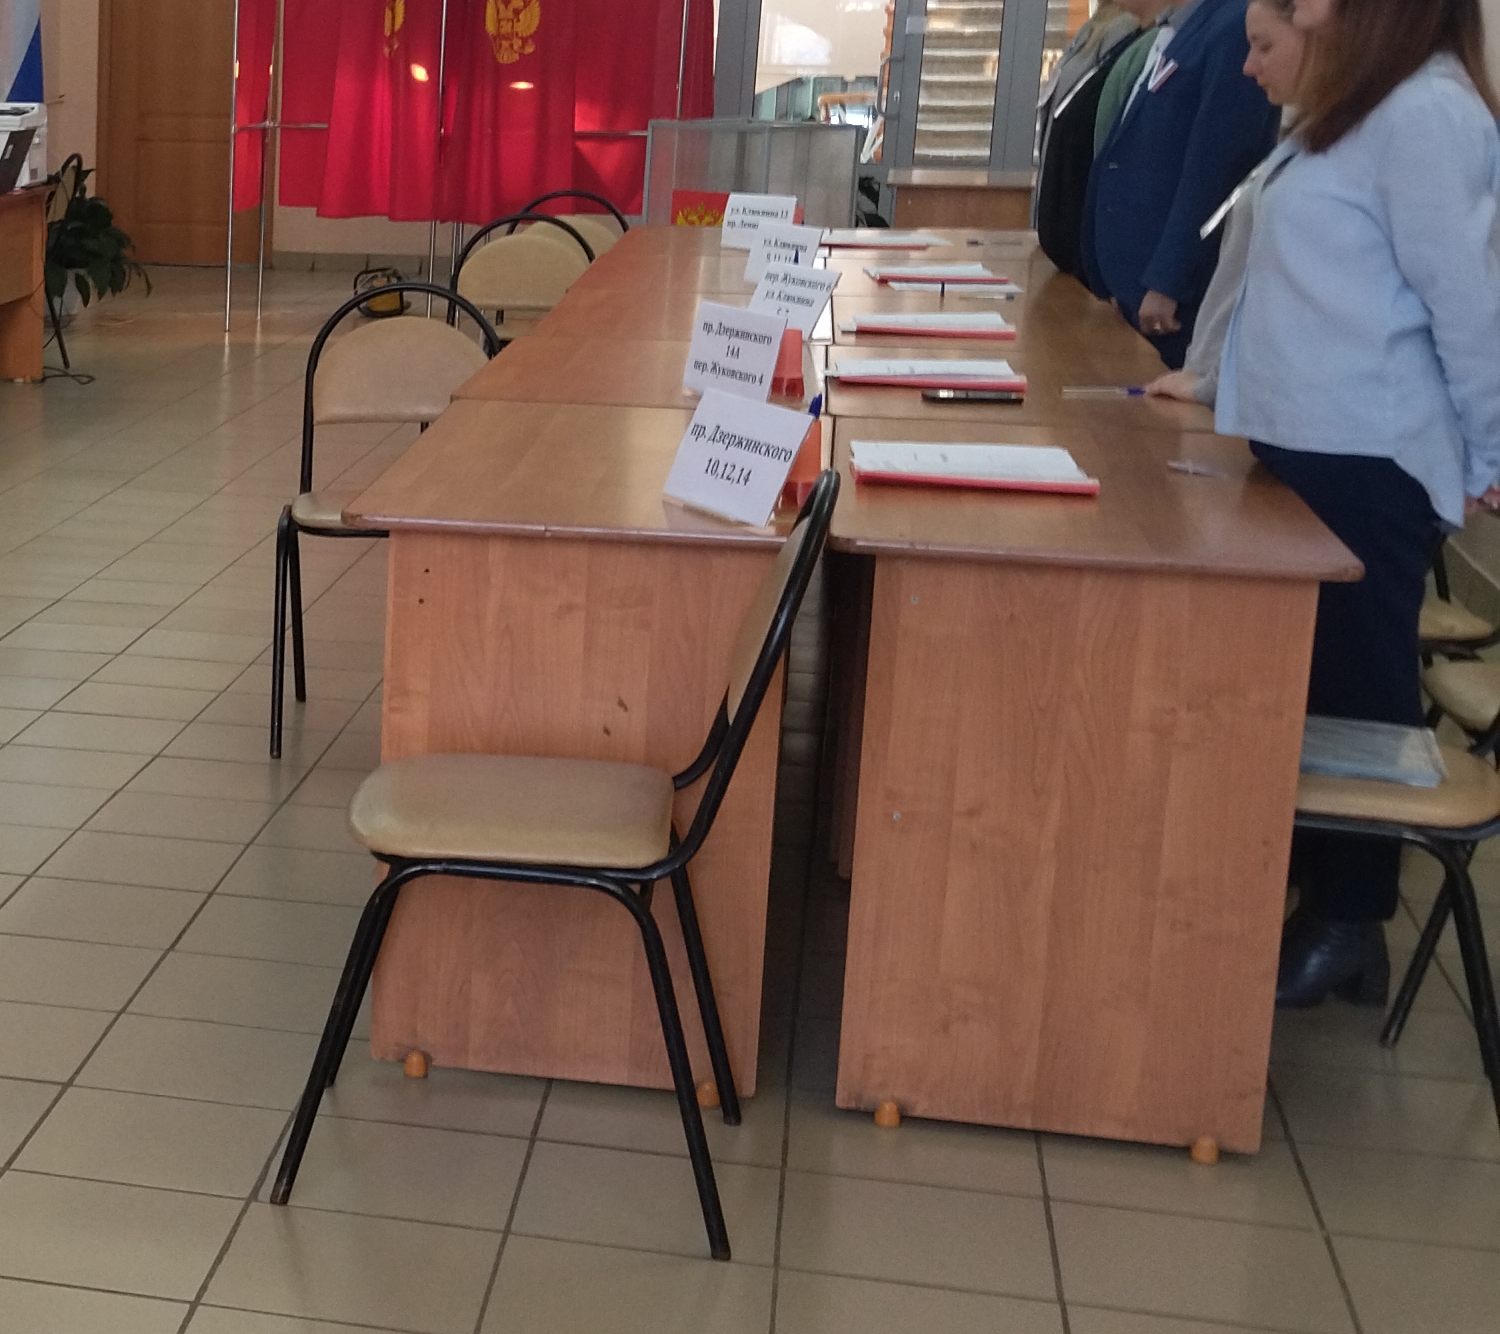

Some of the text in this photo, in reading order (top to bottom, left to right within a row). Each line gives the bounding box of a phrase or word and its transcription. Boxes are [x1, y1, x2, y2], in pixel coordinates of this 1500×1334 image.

[740, 220, 759, 230] Лени
[702, 321, 773, 346] пр. Дзержинского
[725, 345, 740, 359] 14А
[693, 359, 764, 386] пер. Жуковского 4
[690, 421, 793, 463] пр. Дзержинского
[703, 457, 753, 486] 10,12,14
